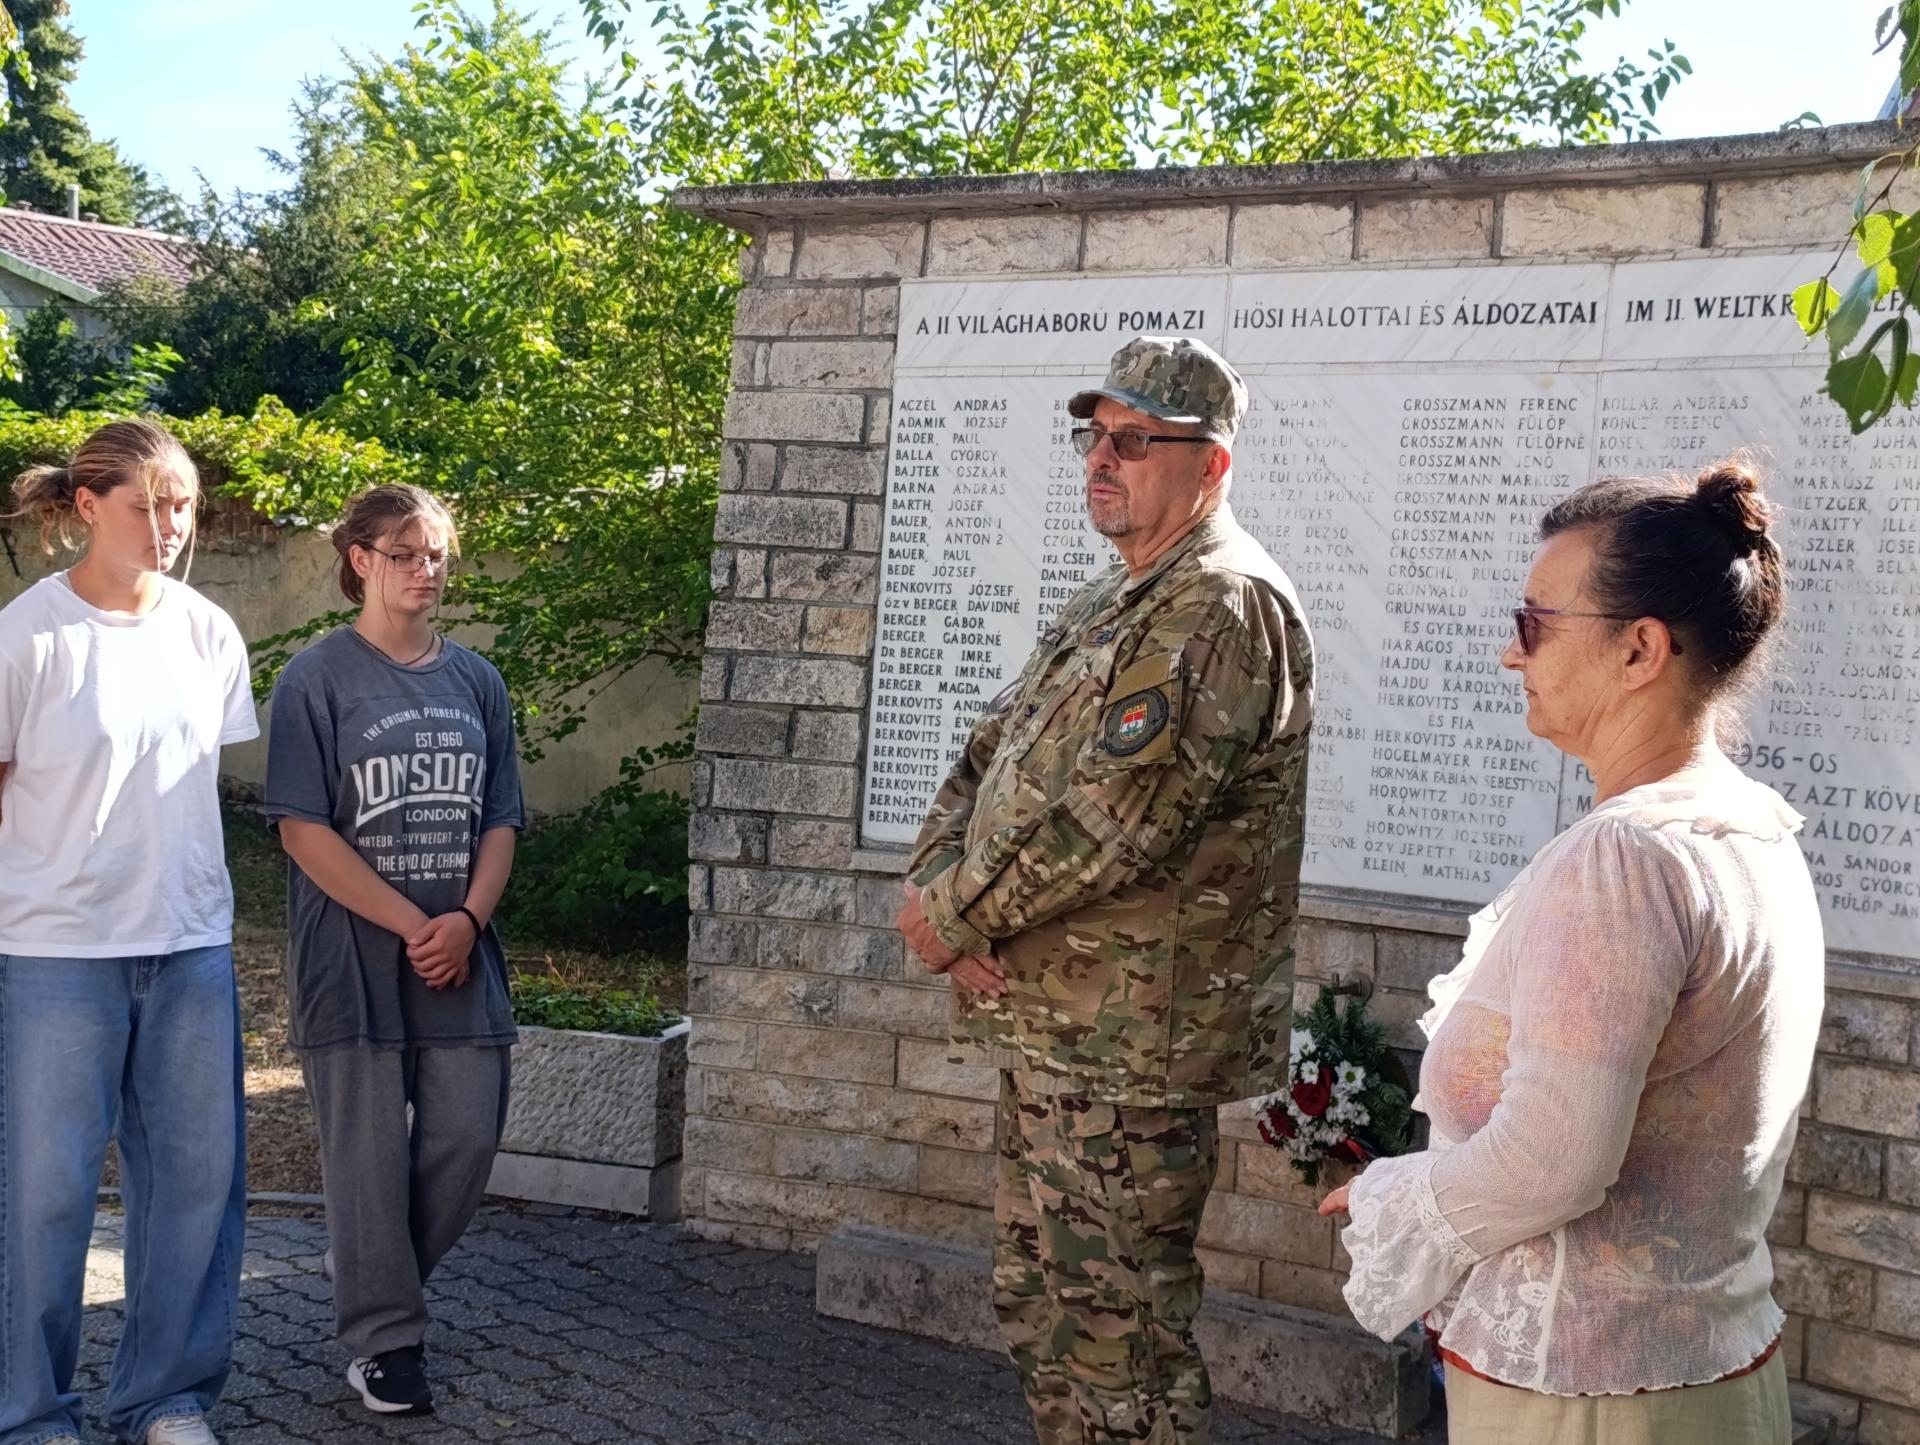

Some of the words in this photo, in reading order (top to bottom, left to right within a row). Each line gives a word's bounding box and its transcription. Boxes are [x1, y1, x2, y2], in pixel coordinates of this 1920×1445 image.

[1292, 306, 1411, 328] HALOTTAI
[1419, 299, 1444, 326] ÉS
[1453, 296, 1597, 326] ÁLDOZATAI
[1626, 300, 1654, 322] IM
[1695, 294, 1794, 320] WELTKR
[916, 317, 929, 335] A
[1520, 398, 1578, 411] FERENC
[898, 417, 946, 428] ADAMIK
[953, 433, 980, 444] PAUL
[895, 450, 933, 461] BALLA
[895, 466, 939, 477] BAJTEK
[893, 483, 935, 494] BARNA
[948, 500, 983, 511] JOSEF
[1395, 491, 1490, 506] GROSSZMANN
[946, 517, 992, 528] ANTON
[1393, 510, 1496, 524] GROSSZMANN
[945, 533, 991, 544] ANTON
[996, 533, 1003, 545] 2
[1392, 528, 1495, 543] GROSSZMANN
[943, 549, 971, 561] PAUL
[1063, 553, 1095, 565] CSEH
[1390, 546, 1493, 562] GROSSZMANN
[887, 565, 915, 576] BEDE
[886, 582, 952, 594] BENKOVITS
[914, 600, 957, 611] BERGER
[883, 614, 926, 626] BERGER
[882, 630, 926, 643] BERGER
[1382, 638, 1453, 654] HARAGOS
[900, 647, 944, 660] BERGER
[961, 651, 992, 663] IMRE
[900, 664, 943, 676] BERGER
[1381, 656, 1430, 670] HAJDU
[878, 679, 922, 691] BERGER
[938, 682, 980, 695] MAGDA
[1379, 675, 1429, 690] HAJDU
[877, 696, 943, 710] BERKOVITS
[1378, 692, 1459, 711] HERKOVITS
[362, 724, 382, 741] THE
[380, 709, 422, 729] ORIGINAL
[423, 707, 460, 719] PIONEER
[876, 712, 941, 726] BERKOVITS
[1451, 716, 1474, 730] FIA
[875, 728, 940, 743] BERKOVITS
[1374, 729, 1456, 748] HERKOVITS
[873, 745, 939, 761] BERKOVITS
[872, 761, 938, 777] BERKOVITS
[1483, 755, 1541, 772] FERENC
[871, 777, 937, 792] BERKOVITS
[1369, 784, 1448, 803] HOROWITZ
[1804, 785, 1857, 808] AZT
[406, 808, 467, 822] LONDON
[1366, 821, 1444, 840] HOROWITZ
[1400, 843, 1455, 859] JERETT
[377, 856, 395, 871] THE
[421, 853, 435, 869] OF
[1423, 864, 1491, 883] MATHIAS
